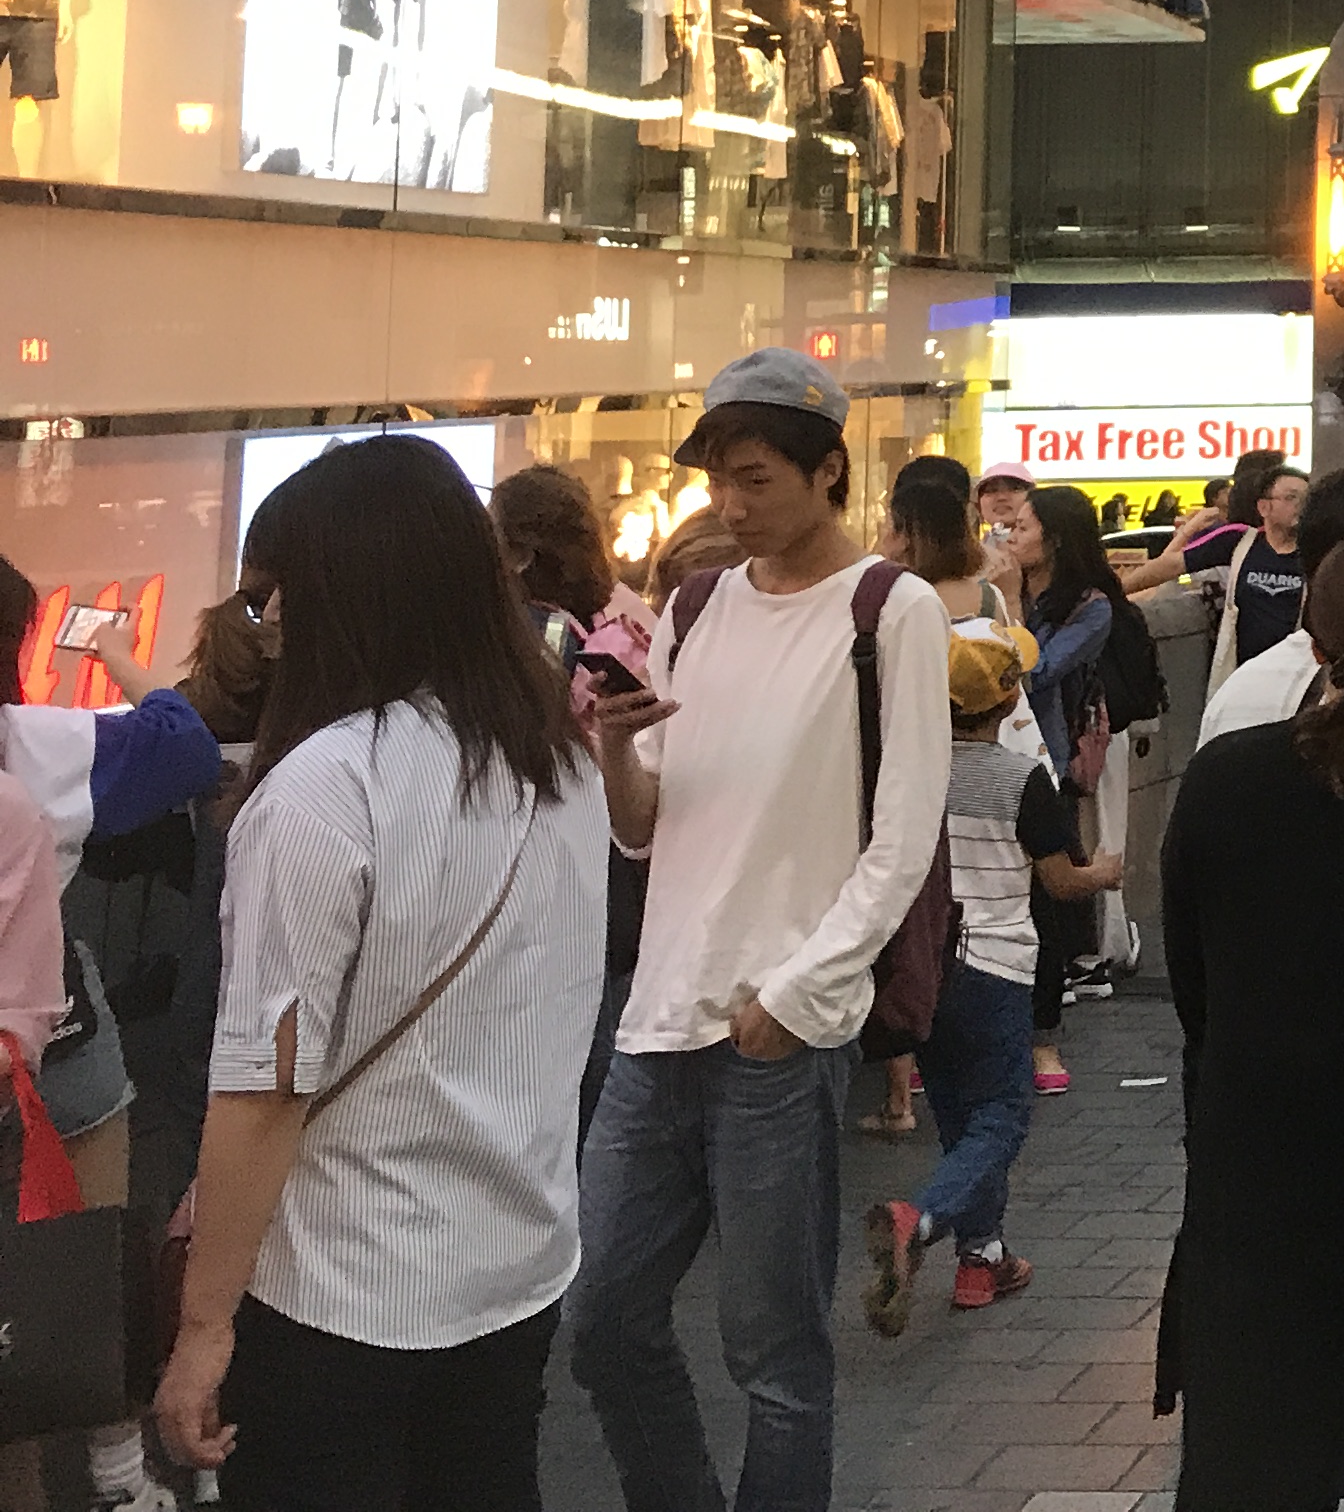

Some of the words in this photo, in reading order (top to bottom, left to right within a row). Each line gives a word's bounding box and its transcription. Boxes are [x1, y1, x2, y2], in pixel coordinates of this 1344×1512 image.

[1015, 423, 1084, 462] Tax
[1098, 421, 1185, 461] Free
[1198, 419, 1302, 459] Shop
